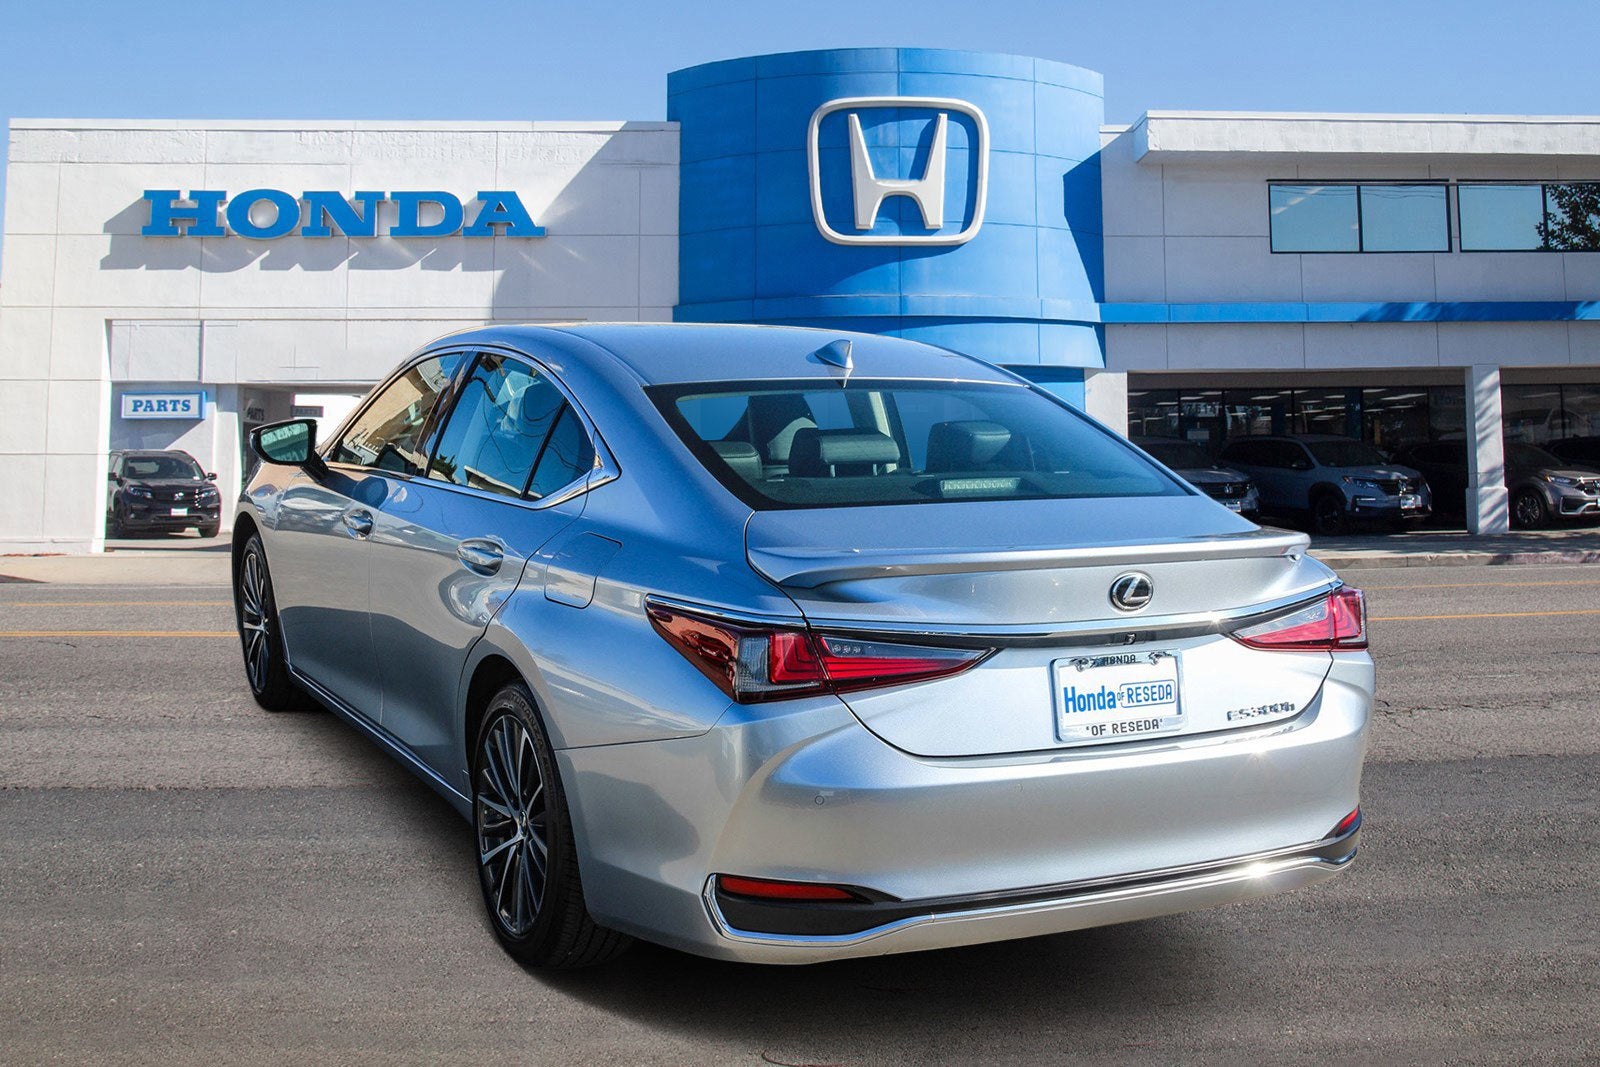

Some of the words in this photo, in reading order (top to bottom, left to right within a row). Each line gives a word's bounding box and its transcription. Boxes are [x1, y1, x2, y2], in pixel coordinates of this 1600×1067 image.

[141, 188, 547, 240] HONDA
[132, 399, 191, 412] PARTS
[1063, 685, 1117, 714] Honda
[1126, 683, 1173, 704] RESEDA
